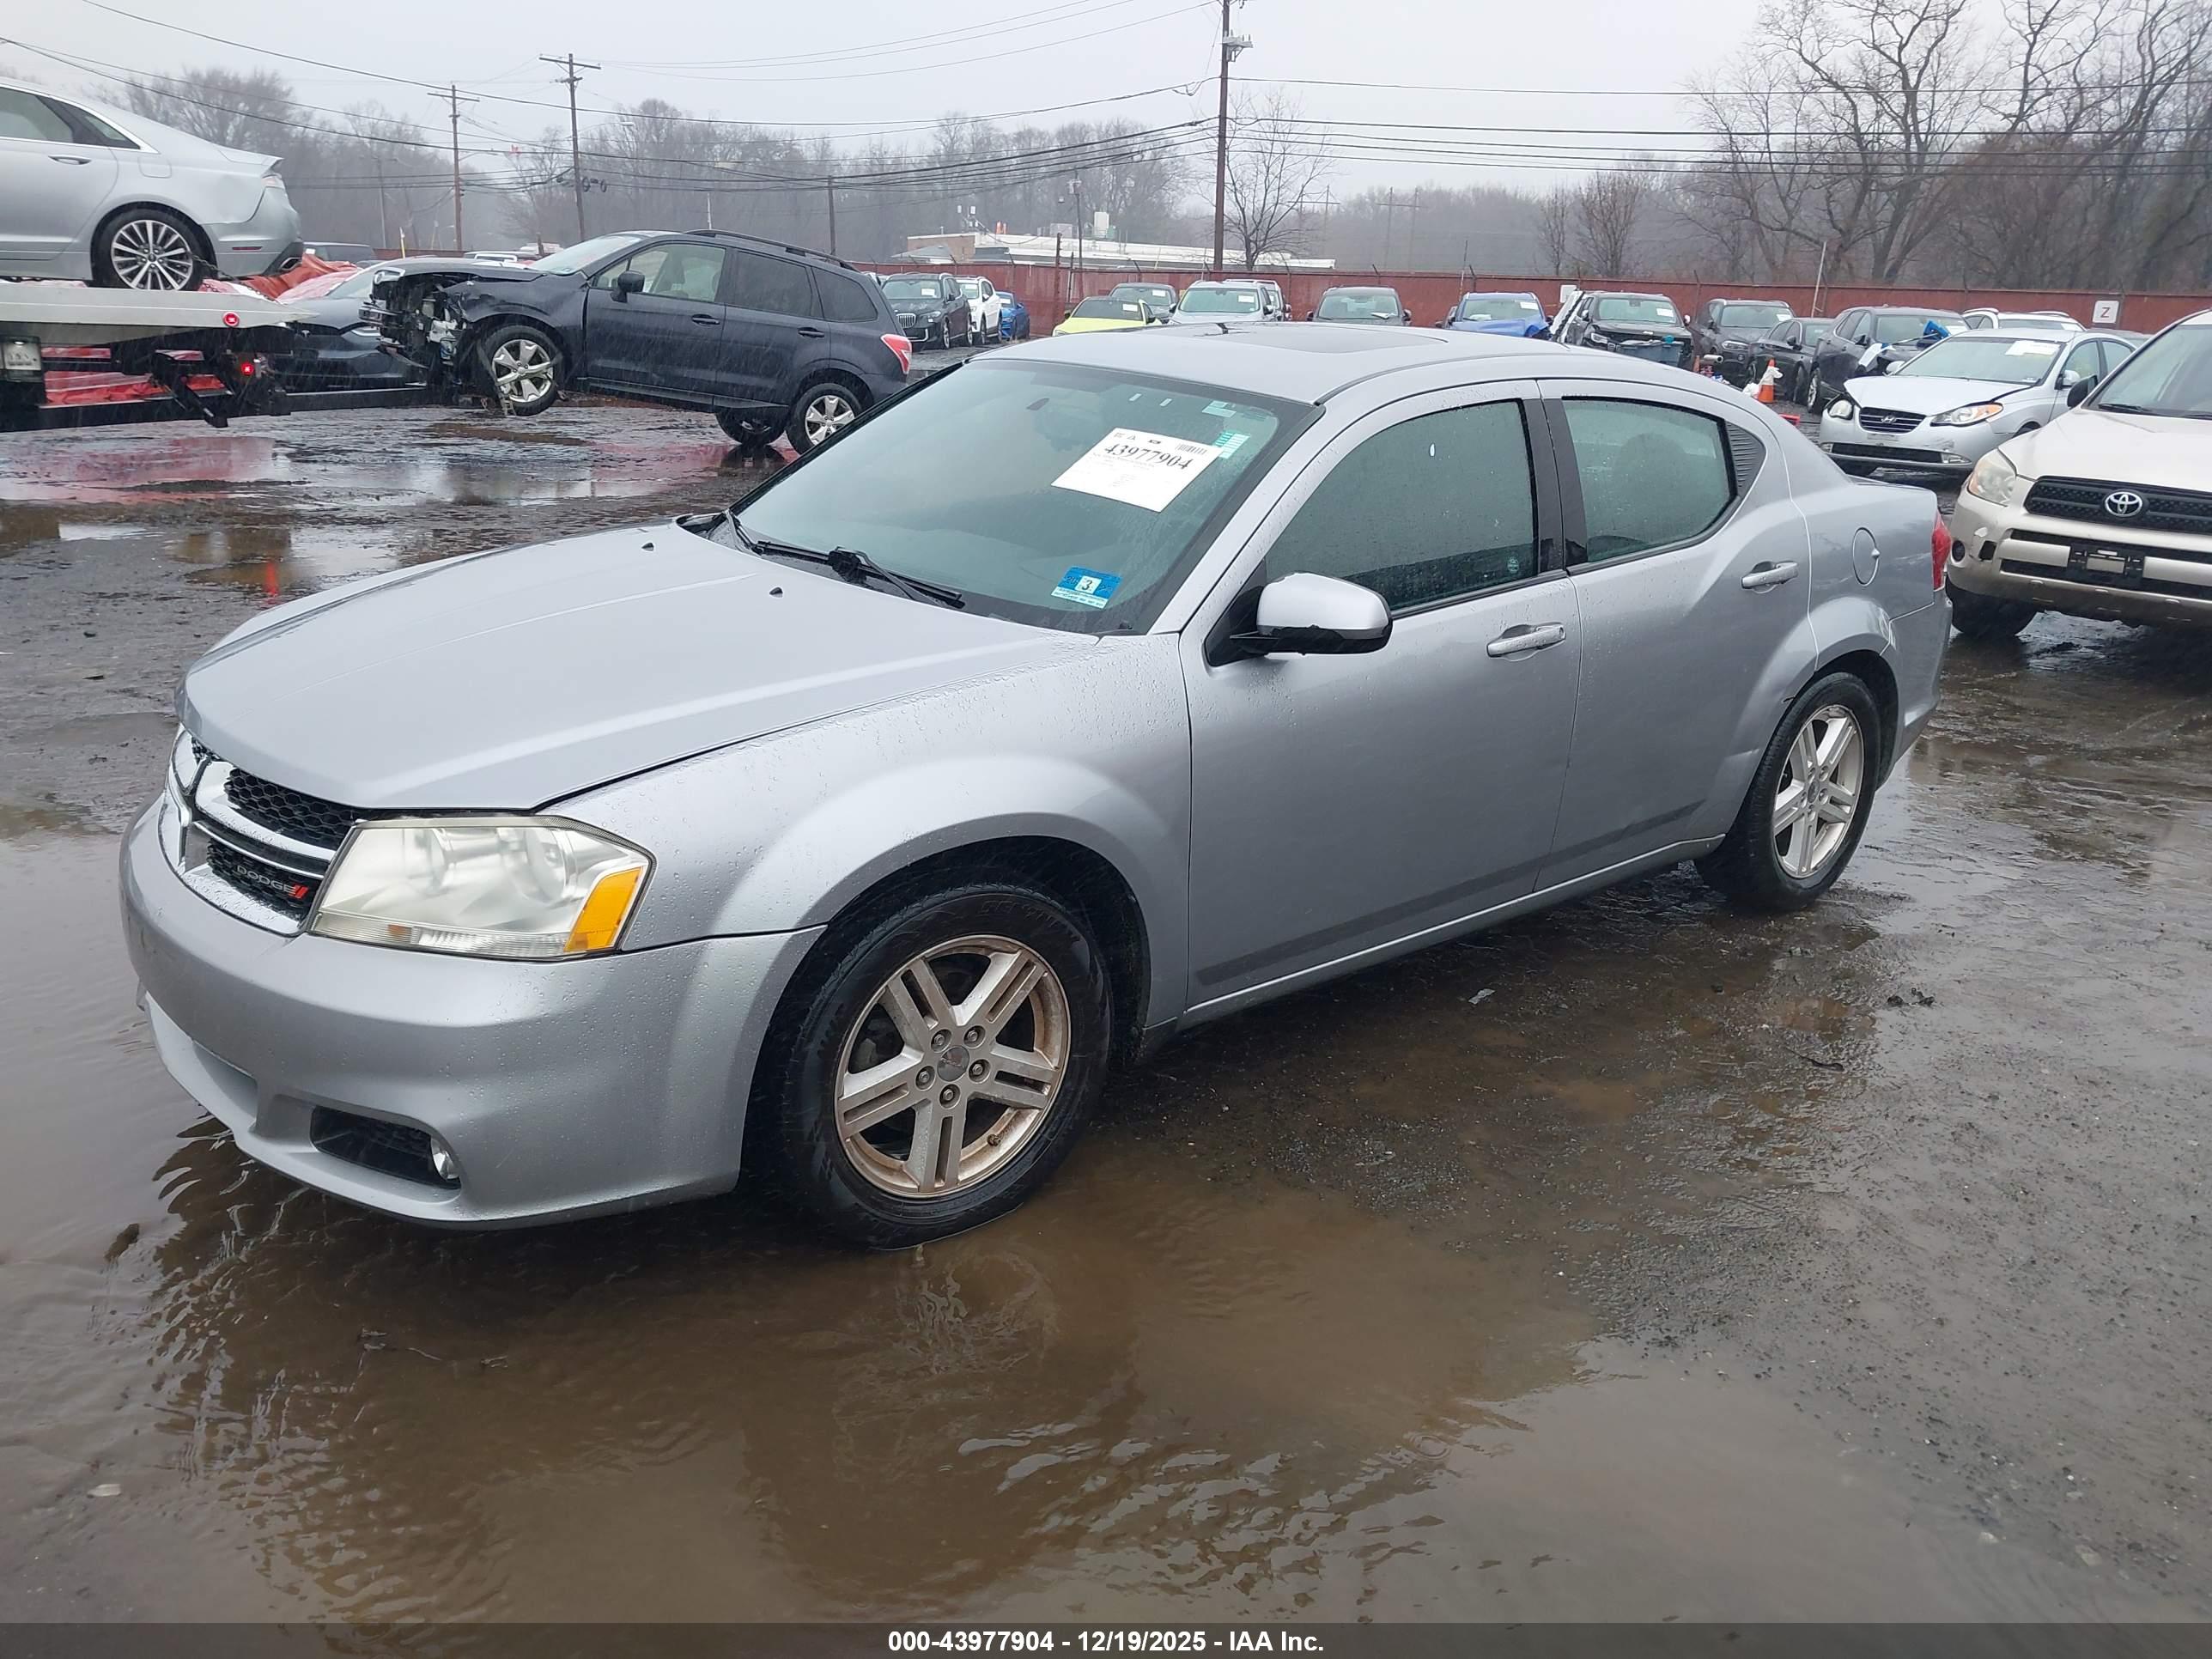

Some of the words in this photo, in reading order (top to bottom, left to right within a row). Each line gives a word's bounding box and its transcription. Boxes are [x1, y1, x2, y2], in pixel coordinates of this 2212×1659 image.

[2100, 307, 2111, 318] Z
[1104, 443, 1194, 470] 43977904
[1081, 580, 1093, 591] 3
[236, 865, 296, 895] DODGE
